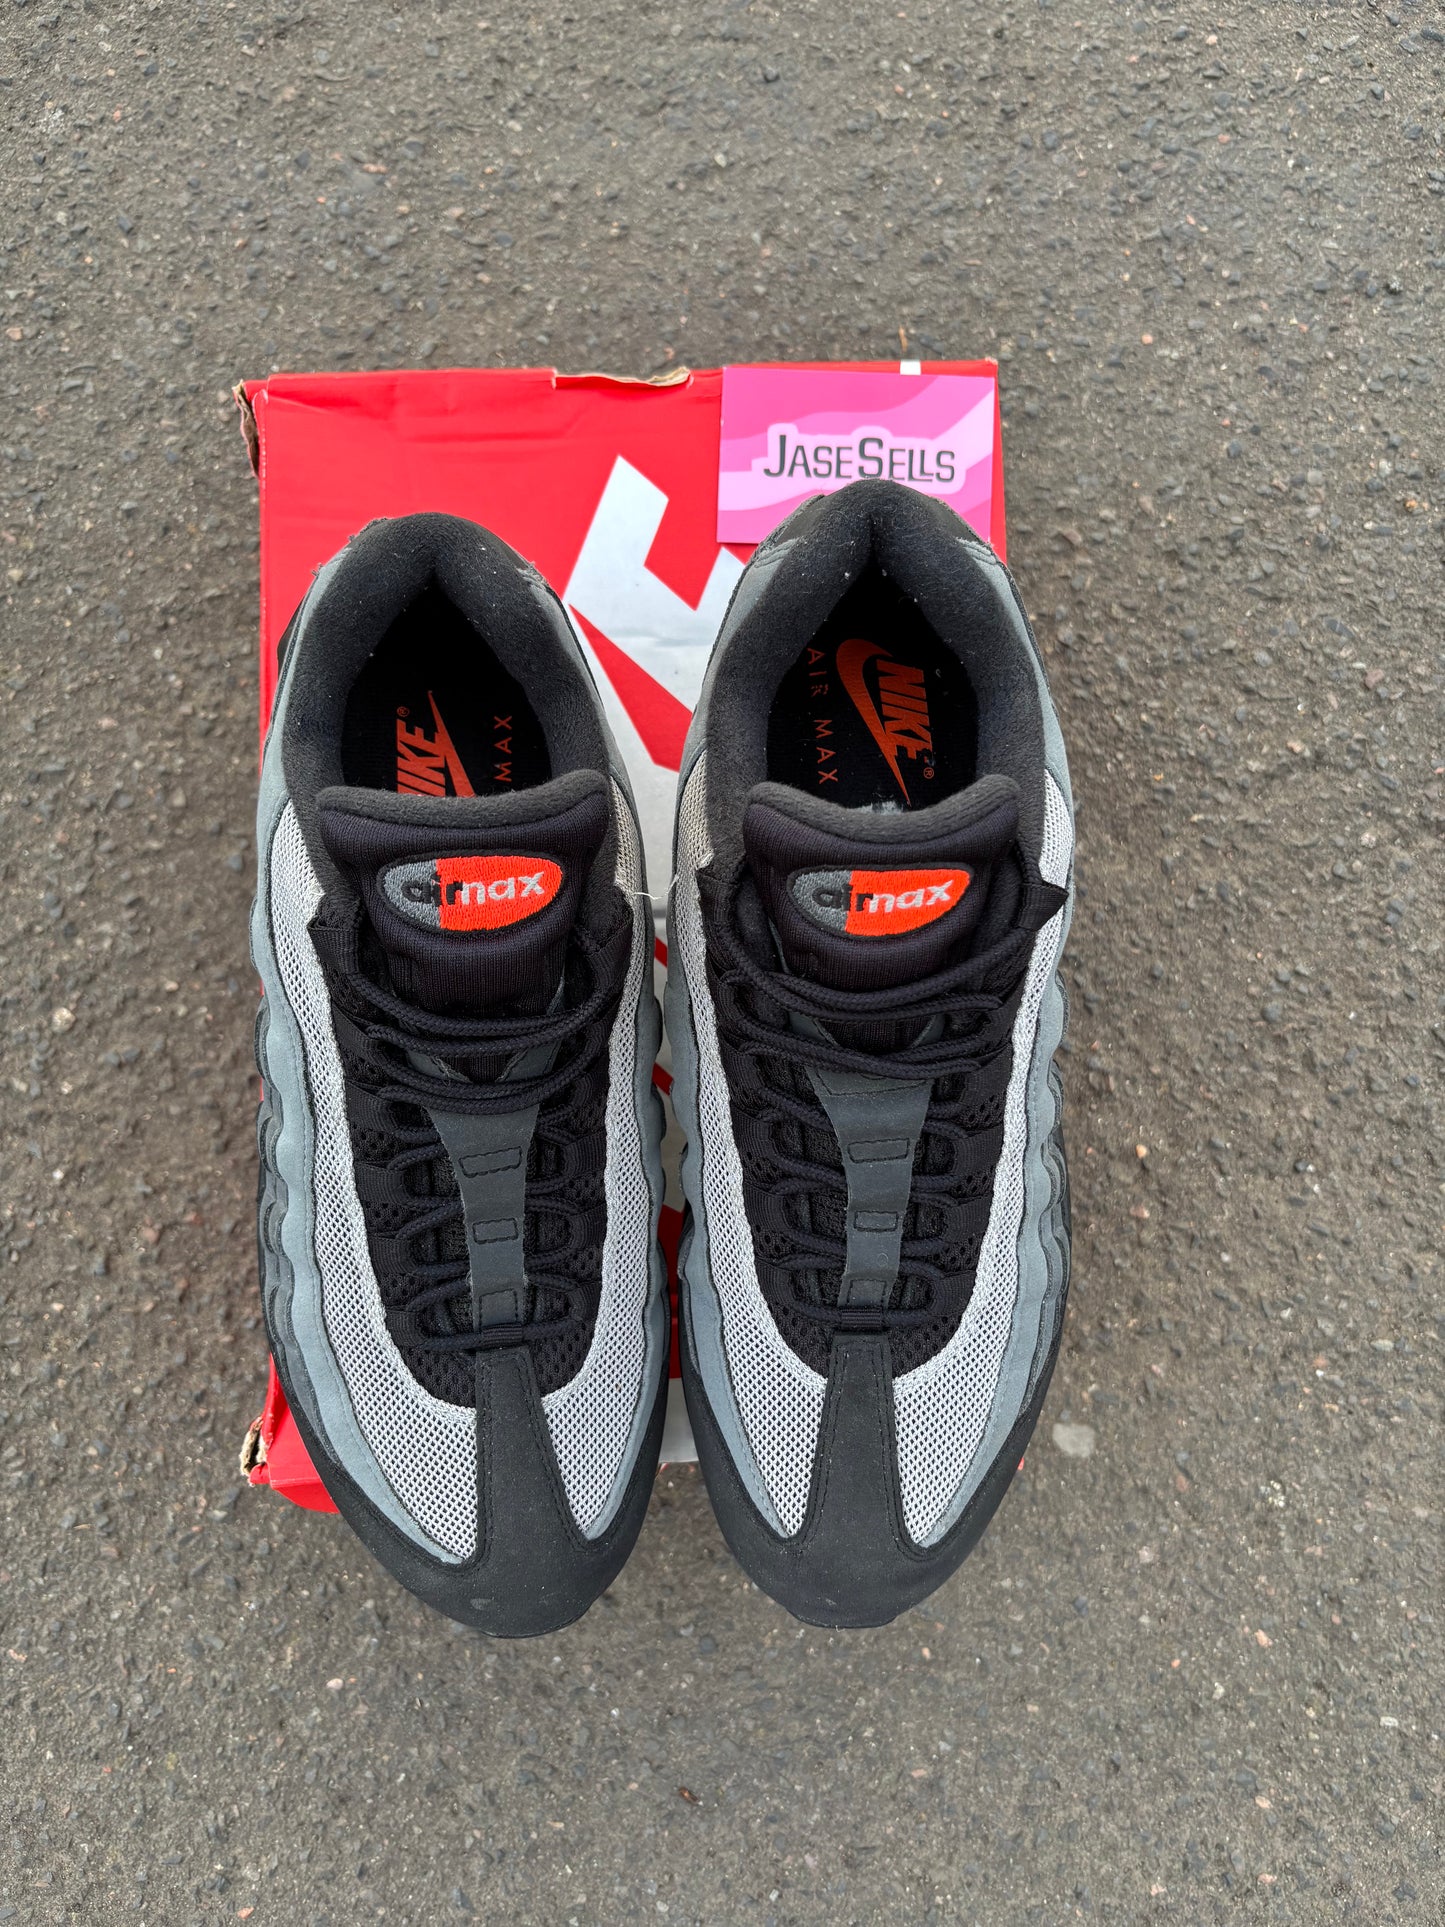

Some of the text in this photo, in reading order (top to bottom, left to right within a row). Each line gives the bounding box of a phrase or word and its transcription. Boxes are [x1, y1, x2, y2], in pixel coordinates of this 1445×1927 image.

[876, 659, 933, 760] NIKE
[494, 715, 513, 782] MAX
[813, 719, 838, 784] MAX
